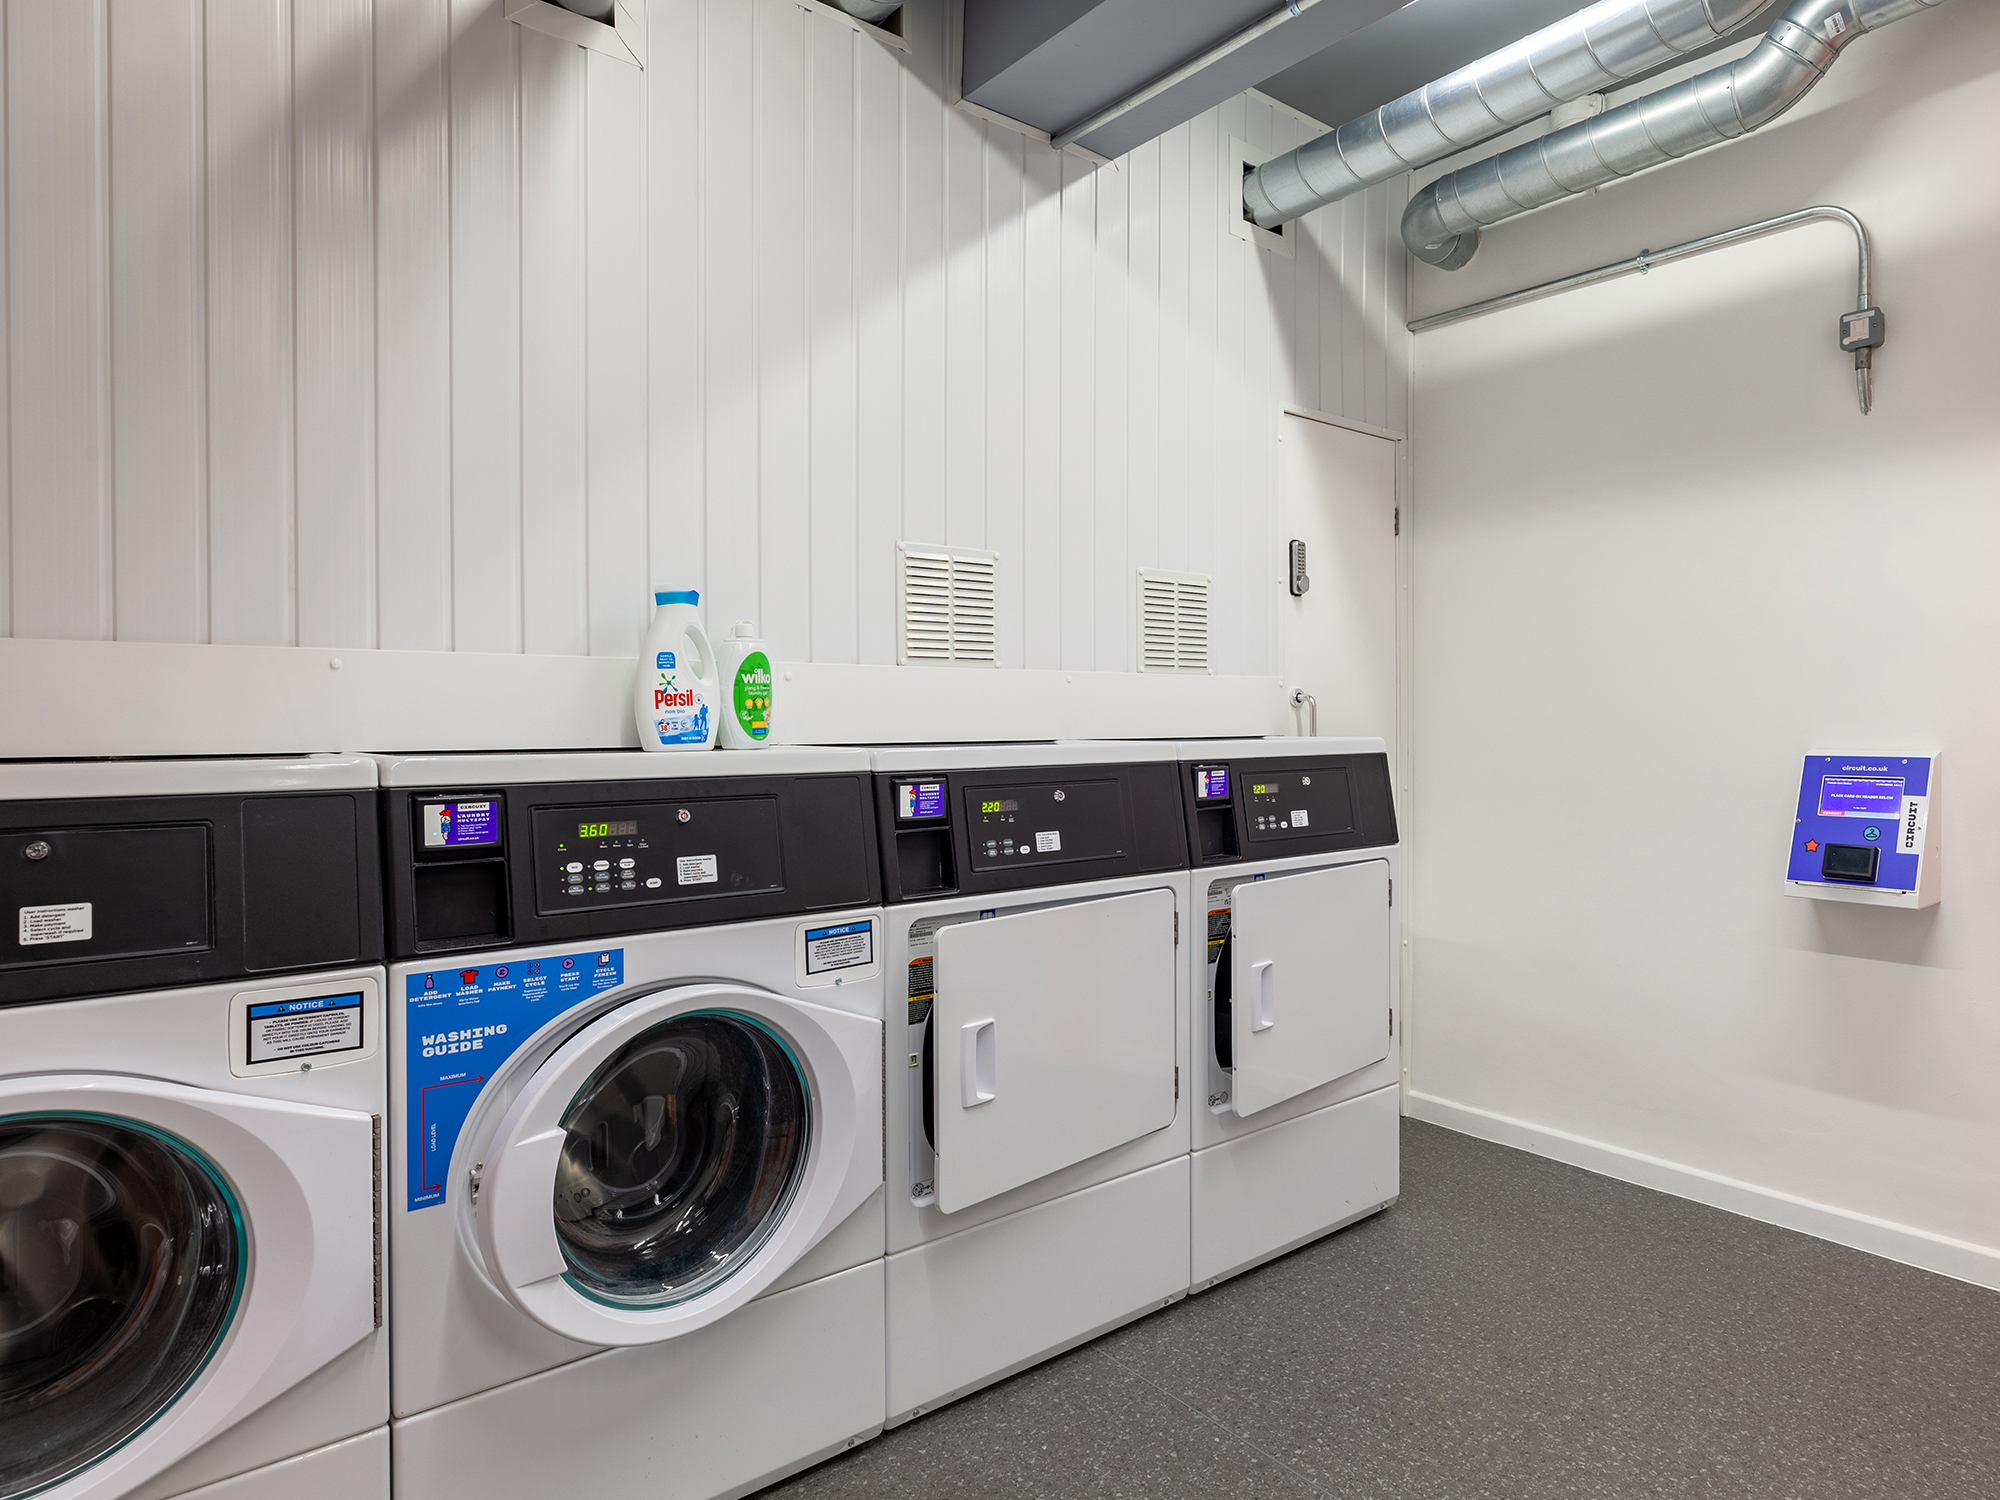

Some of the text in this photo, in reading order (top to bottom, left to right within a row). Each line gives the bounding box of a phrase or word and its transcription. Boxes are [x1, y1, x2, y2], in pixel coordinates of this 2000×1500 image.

[741, 669, 770, 684] wilko
[654, 689, 693, 709] Persil
[1905, 801, 1918, 848] CIRCUIT
[580, 823, 608, 838] 3.60
[829, 927, 849, 935] NOTICE
[523, 975, 547, 983] SELECT
[455, 988, 483, 996] WASHER
[488, 984, 517, 992] PAYMENT
[409, 992, 452, 1003] DETERGENT
[289, 1000, 324, 1011] NOTICE
[422, 1024, 508, 1046] WASHING
[422, 1038, 484, 1058] GUIDE
[439, 1072, 467, 1081] MAXIMUM
[414, 1192, 440, 1203] MINIMUM
